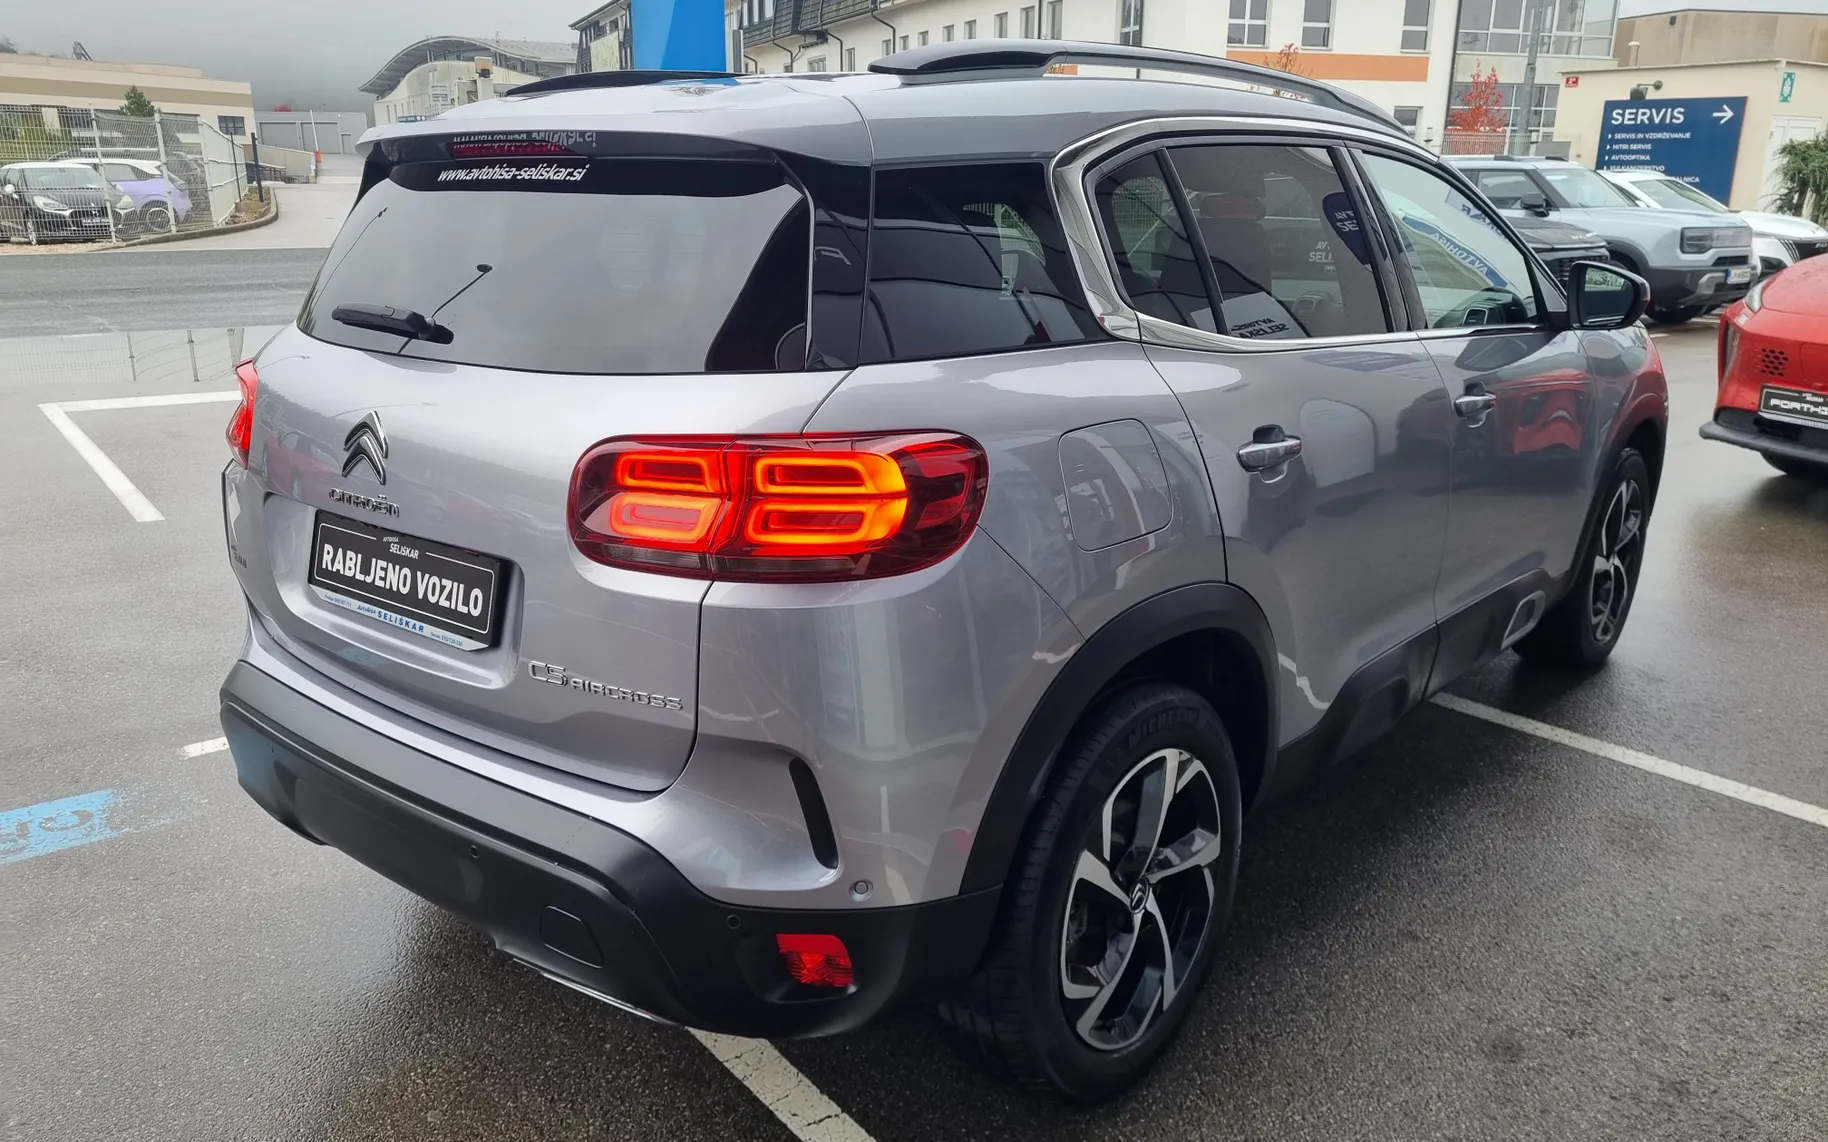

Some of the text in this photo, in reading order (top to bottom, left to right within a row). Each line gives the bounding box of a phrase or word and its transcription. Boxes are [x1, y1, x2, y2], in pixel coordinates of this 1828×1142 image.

[1610, 107, 1685, 125] SERVIS
[438, 164, 590, 182] www.avtohisa-seliskar.si
[321, 543, 483, 617] RABLJENO VOZILO
[528, 660, 683, 711] C5 AIRCROSS
